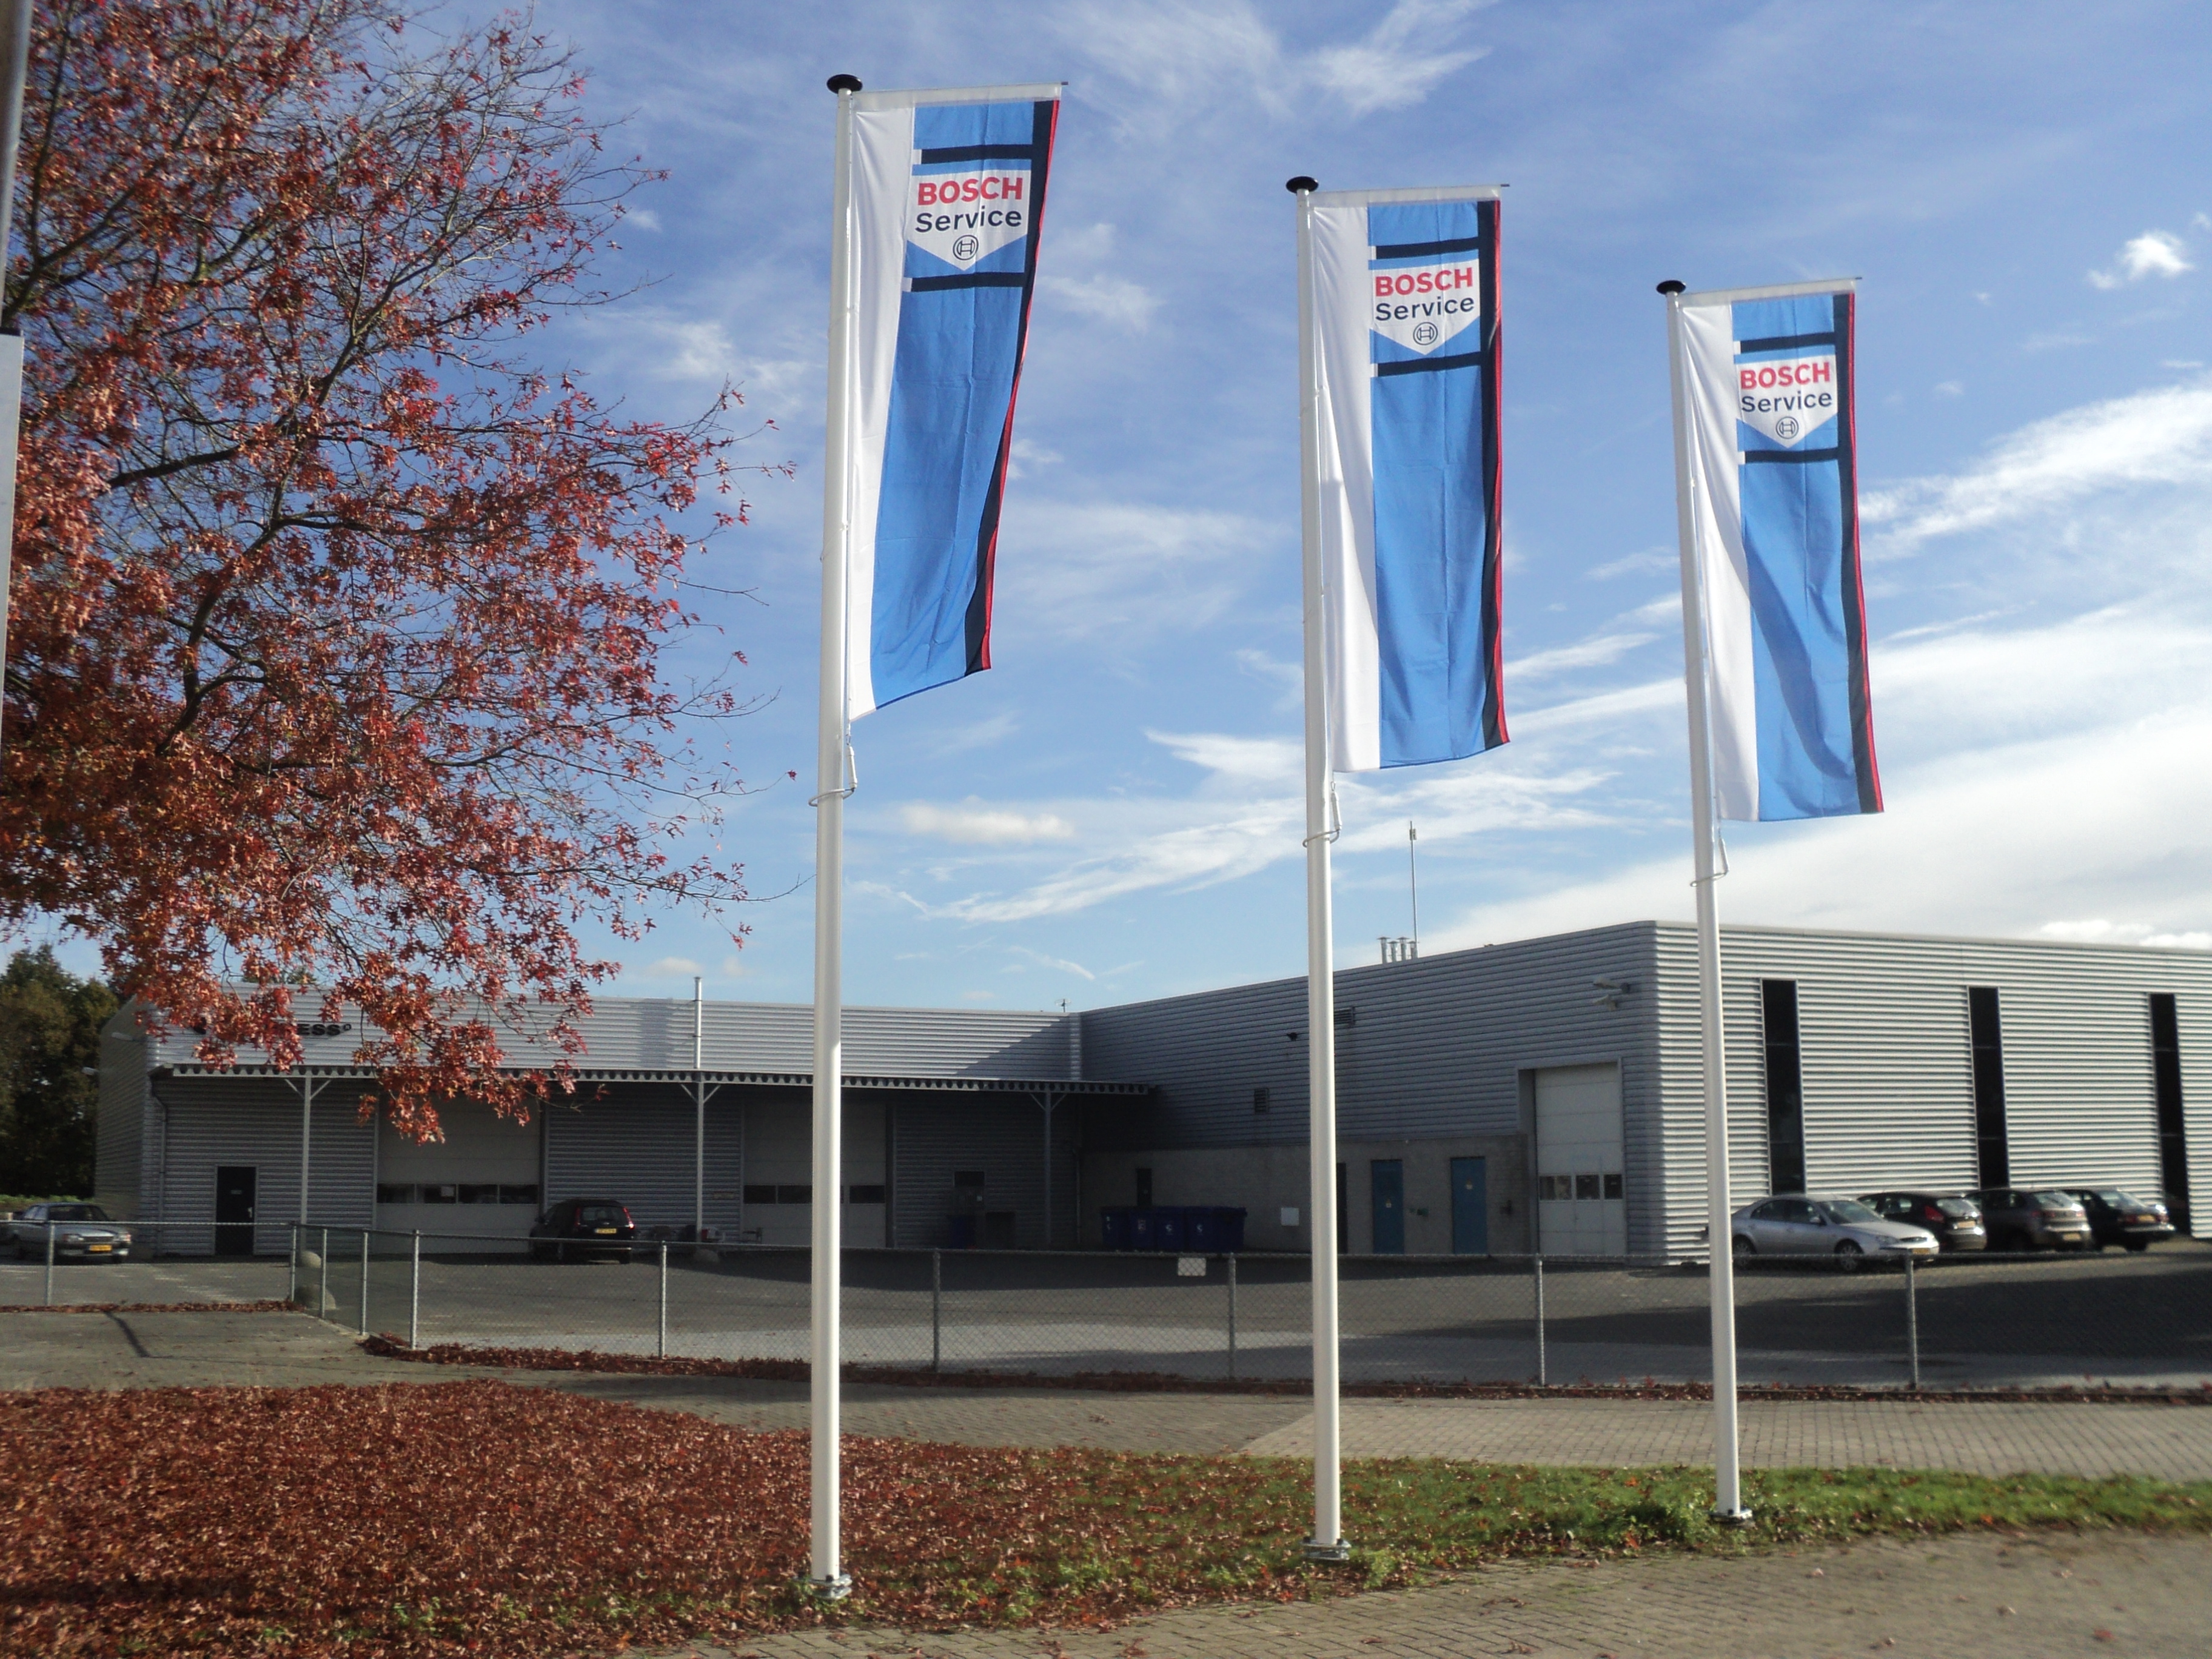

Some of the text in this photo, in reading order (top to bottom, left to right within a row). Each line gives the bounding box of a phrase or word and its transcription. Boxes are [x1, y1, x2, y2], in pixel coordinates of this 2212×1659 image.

[917, 176, 1024, 206] BOSCH
[915, 205, 1022, 233] Service
[1375, 267, 1473, 297] BOSCH
[1375, 296, 1475, 321] Service
[1740, 362, 1830, 390] BOSCH
[1741, 390, 1832, 412] Service
